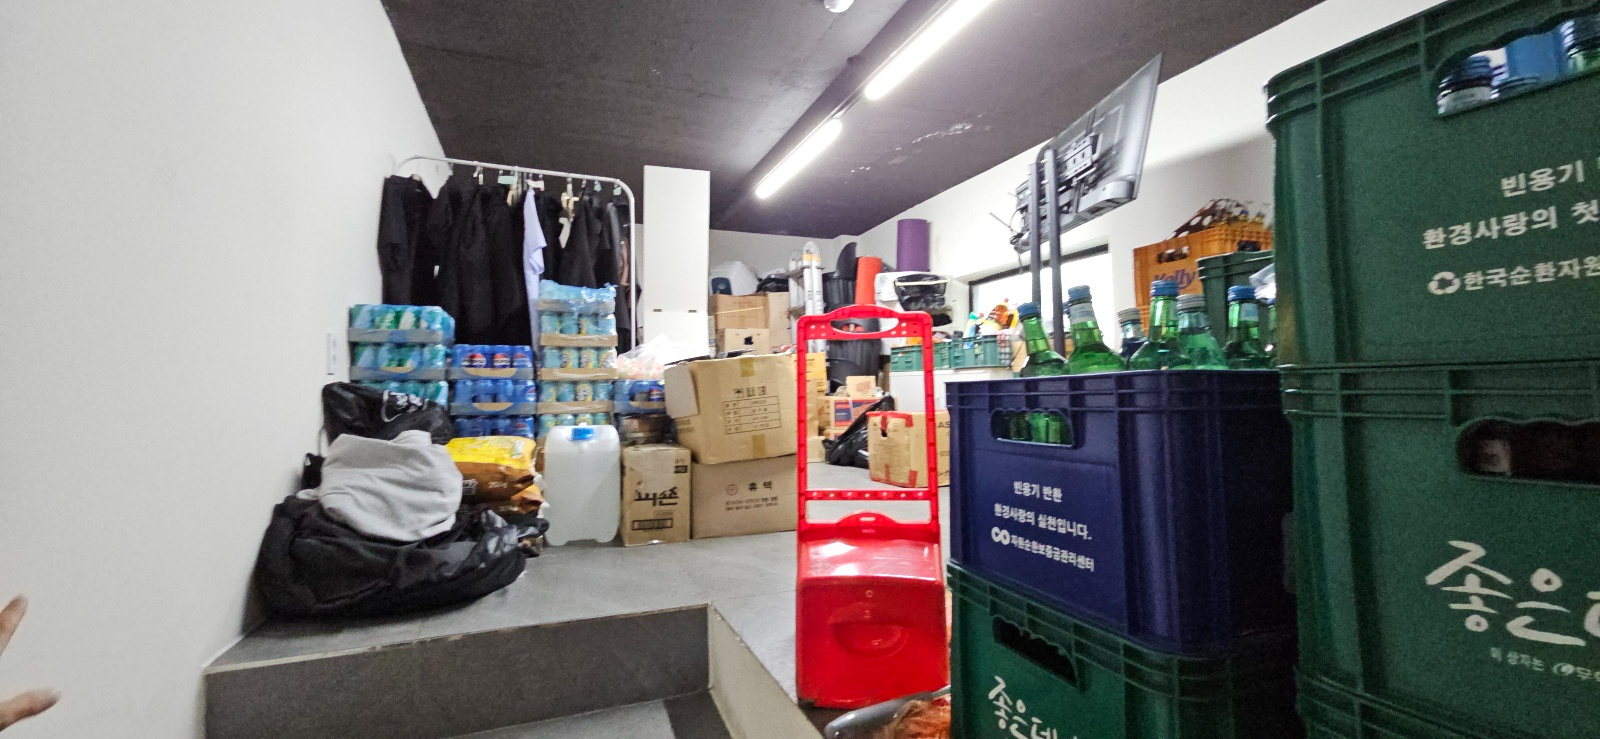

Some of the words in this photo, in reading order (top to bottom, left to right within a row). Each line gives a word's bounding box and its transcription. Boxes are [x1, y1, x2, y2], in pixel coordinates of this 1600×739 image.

[1500, 159, 1585, 198] 빈용기
[1422, 205, 1558, 250] 환경사랑의
[1013, 480, 1041, 499] 빈용기
[1042, 486, 1063, 503] 반환
[993, 502, 1036, 526] 환경사랑의
[1037, 513, 1093, 540] 실천입니다.
[1010, 534, 1095, 573] 자원순환보증금관리센터
